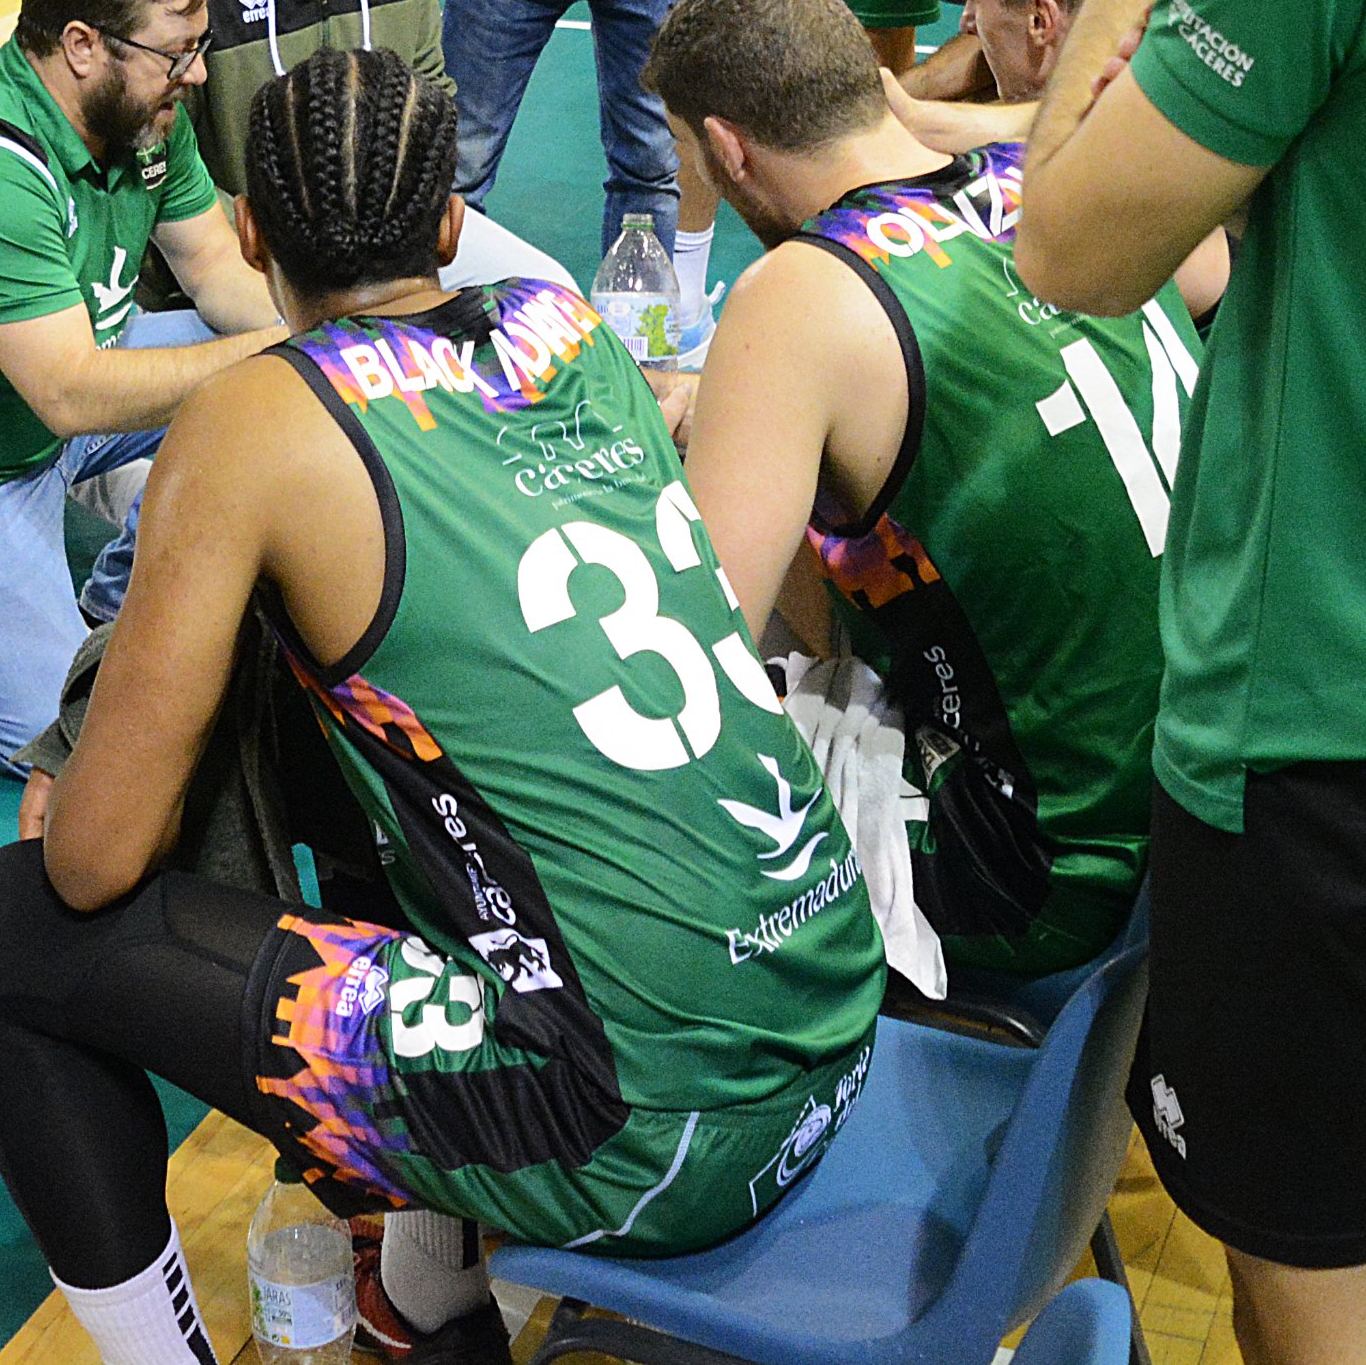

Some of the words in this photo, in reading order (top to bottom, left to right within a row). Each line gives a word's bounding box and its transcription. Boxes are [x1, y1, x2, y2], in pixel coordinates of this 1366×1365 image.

[339, 337, 500, 400] BLACK
[726, 844, 861, 966] Extremadur
[335, 955, 372, 1018] errea
